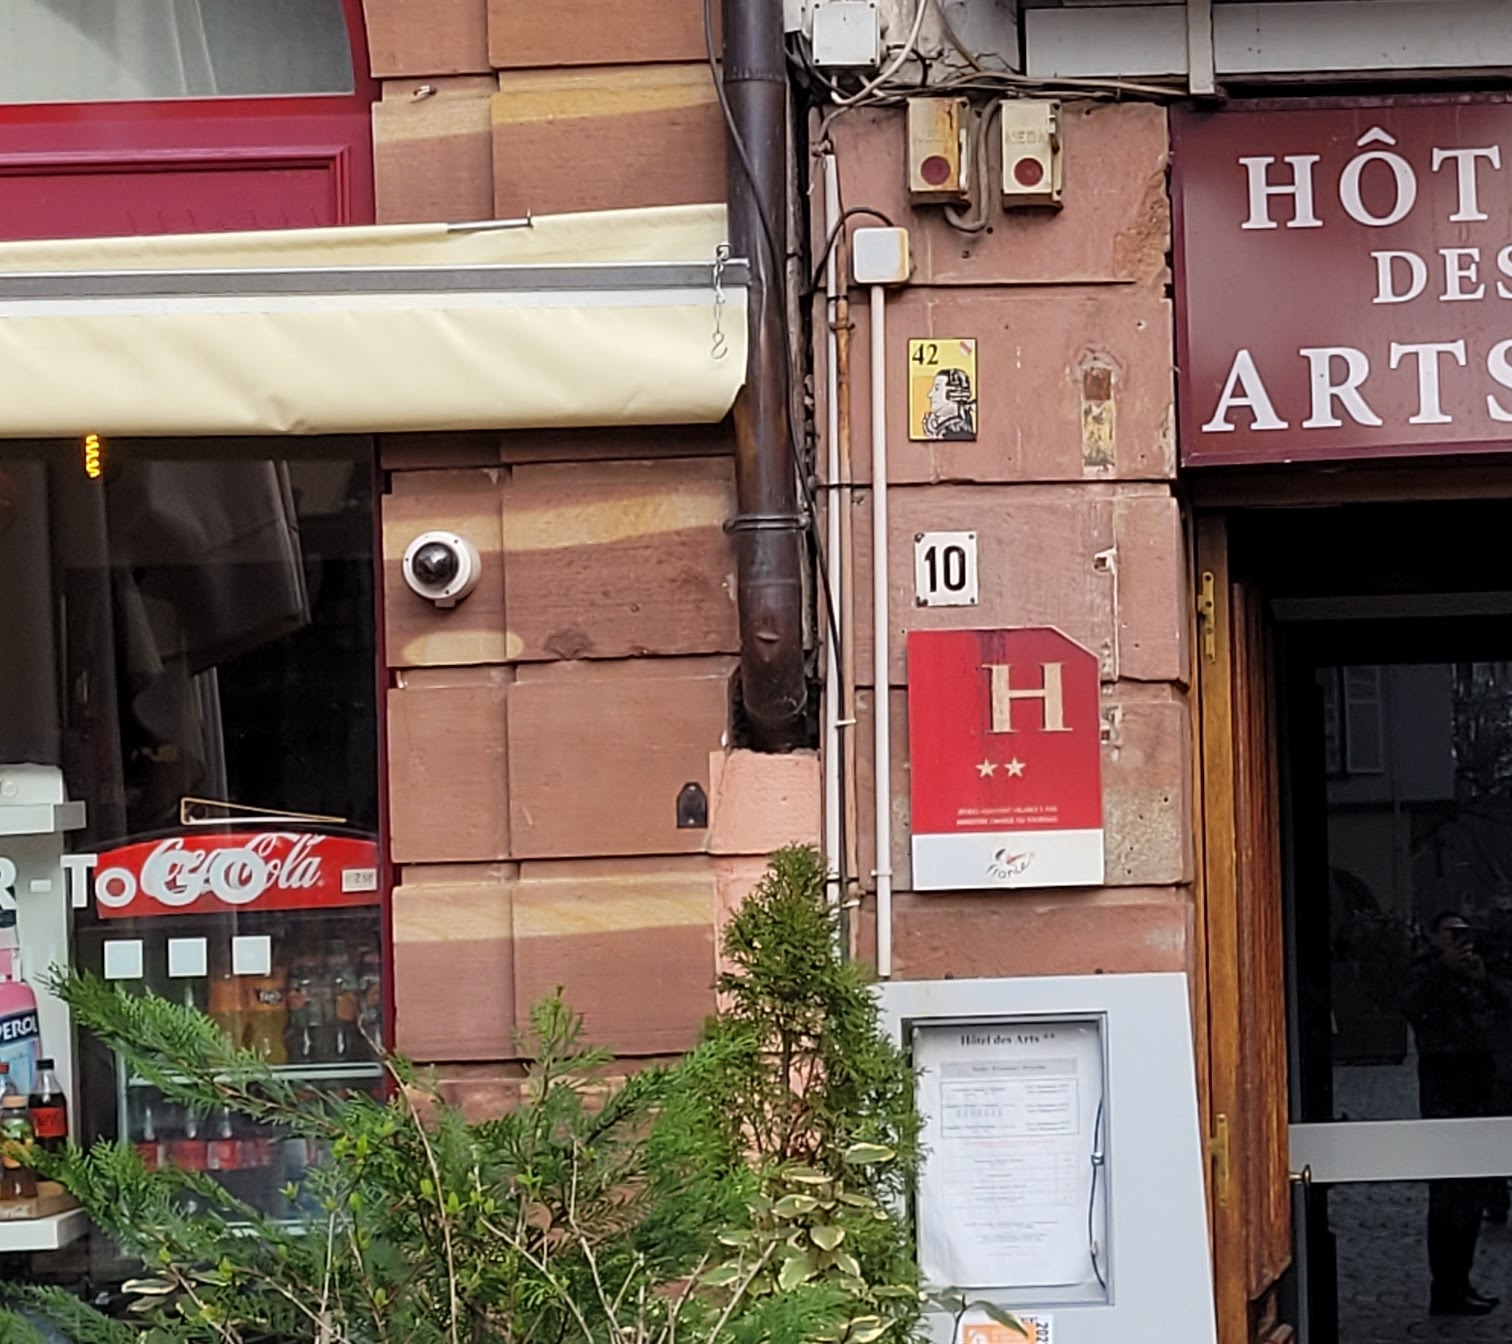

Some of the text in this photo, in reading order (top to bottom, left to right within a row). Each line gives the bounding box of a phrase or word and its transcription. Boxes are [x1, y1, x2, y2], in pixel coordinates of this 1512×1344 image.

[911, 342, 939, 365] 42
[924, 545, 967, 594] 10
[981, 661, 1073, 735] H
[140, 832, 326, 899] CcaCola
[993, 1033, 1012, 1045] des
[1016, 1032, 1040, 1044] Arts
